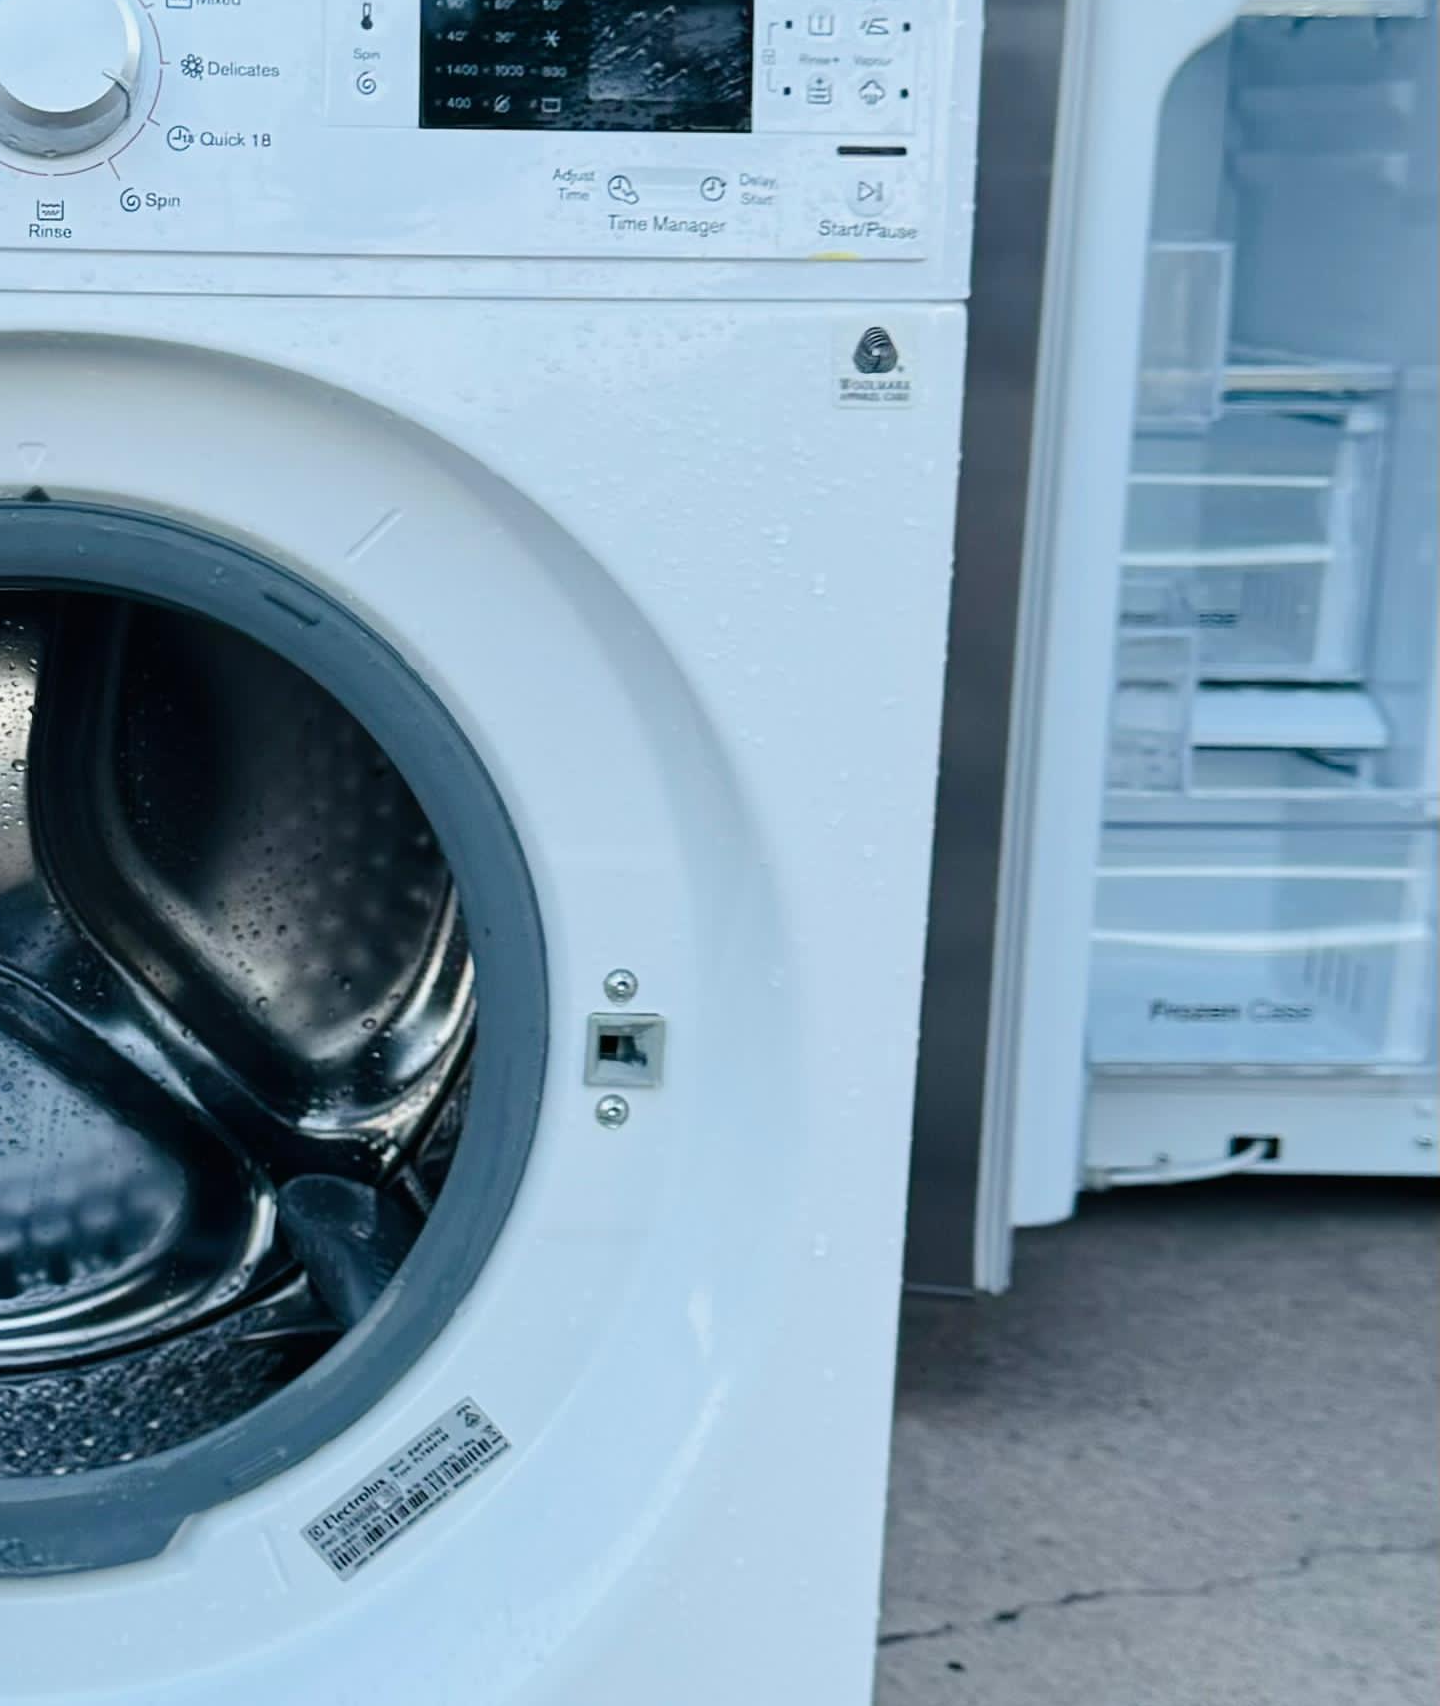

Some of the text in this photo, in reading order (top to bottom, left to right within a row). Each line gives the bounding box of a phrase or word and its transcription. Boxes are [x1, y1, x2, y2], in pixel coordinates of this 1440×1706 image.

[353, 48, 381, 63] Spin
[207, 61, 280, 79] Delicates
[447, 96, 472, 109] 400
[199, 133, 246, 149] Quick
[252, 133, 272, 148] 18
[552, 168, 596, 185] Adjust
[145, 192, 182, 210] Spin
[558, 188, 591, 201] Time
[740, 192, 773, 205] Start
[28, 223, 73, 239] Rinse
[607, 214, 727, 237] Time Manager
[322, 1477, 388, 1530] Electrolux
